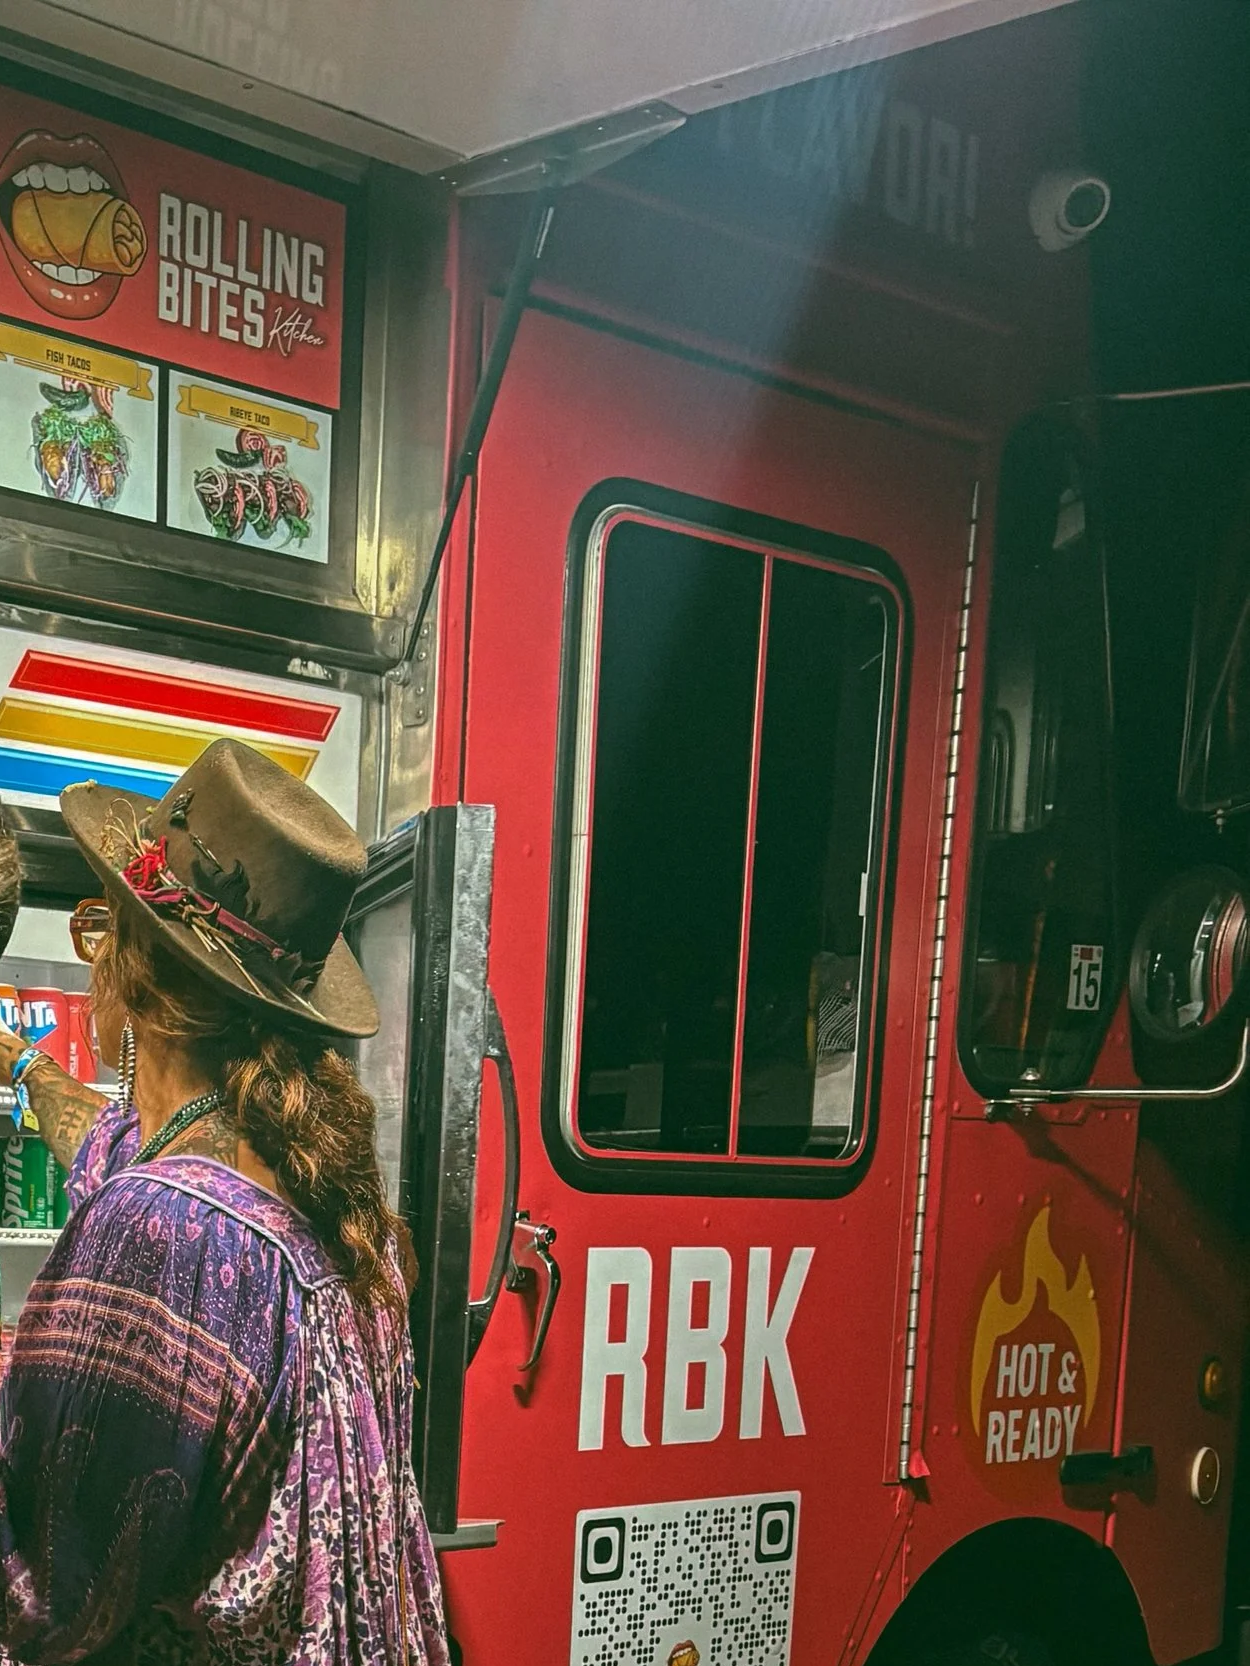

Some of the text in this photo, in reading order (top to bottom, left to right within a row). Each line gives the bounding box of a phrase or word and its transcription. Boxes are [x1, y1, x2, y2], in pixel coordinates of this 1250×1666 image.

[159, 193, 325, 307] ROLLING
[158, 259, 324, 357] BITES Kitchen
[46, 349, 91, 372] FISH TACOS
[230, 406, 270, 426] RIBEYE TACO
[1073, 961, 1100, 1009] 15
[2, 1136, 29, 1228] Sprite
[578, 1246, 816, 1451] RBK
[996, 1343, 1078, 1398] HOT &
[985, 1405, 1082, 1464] READY
